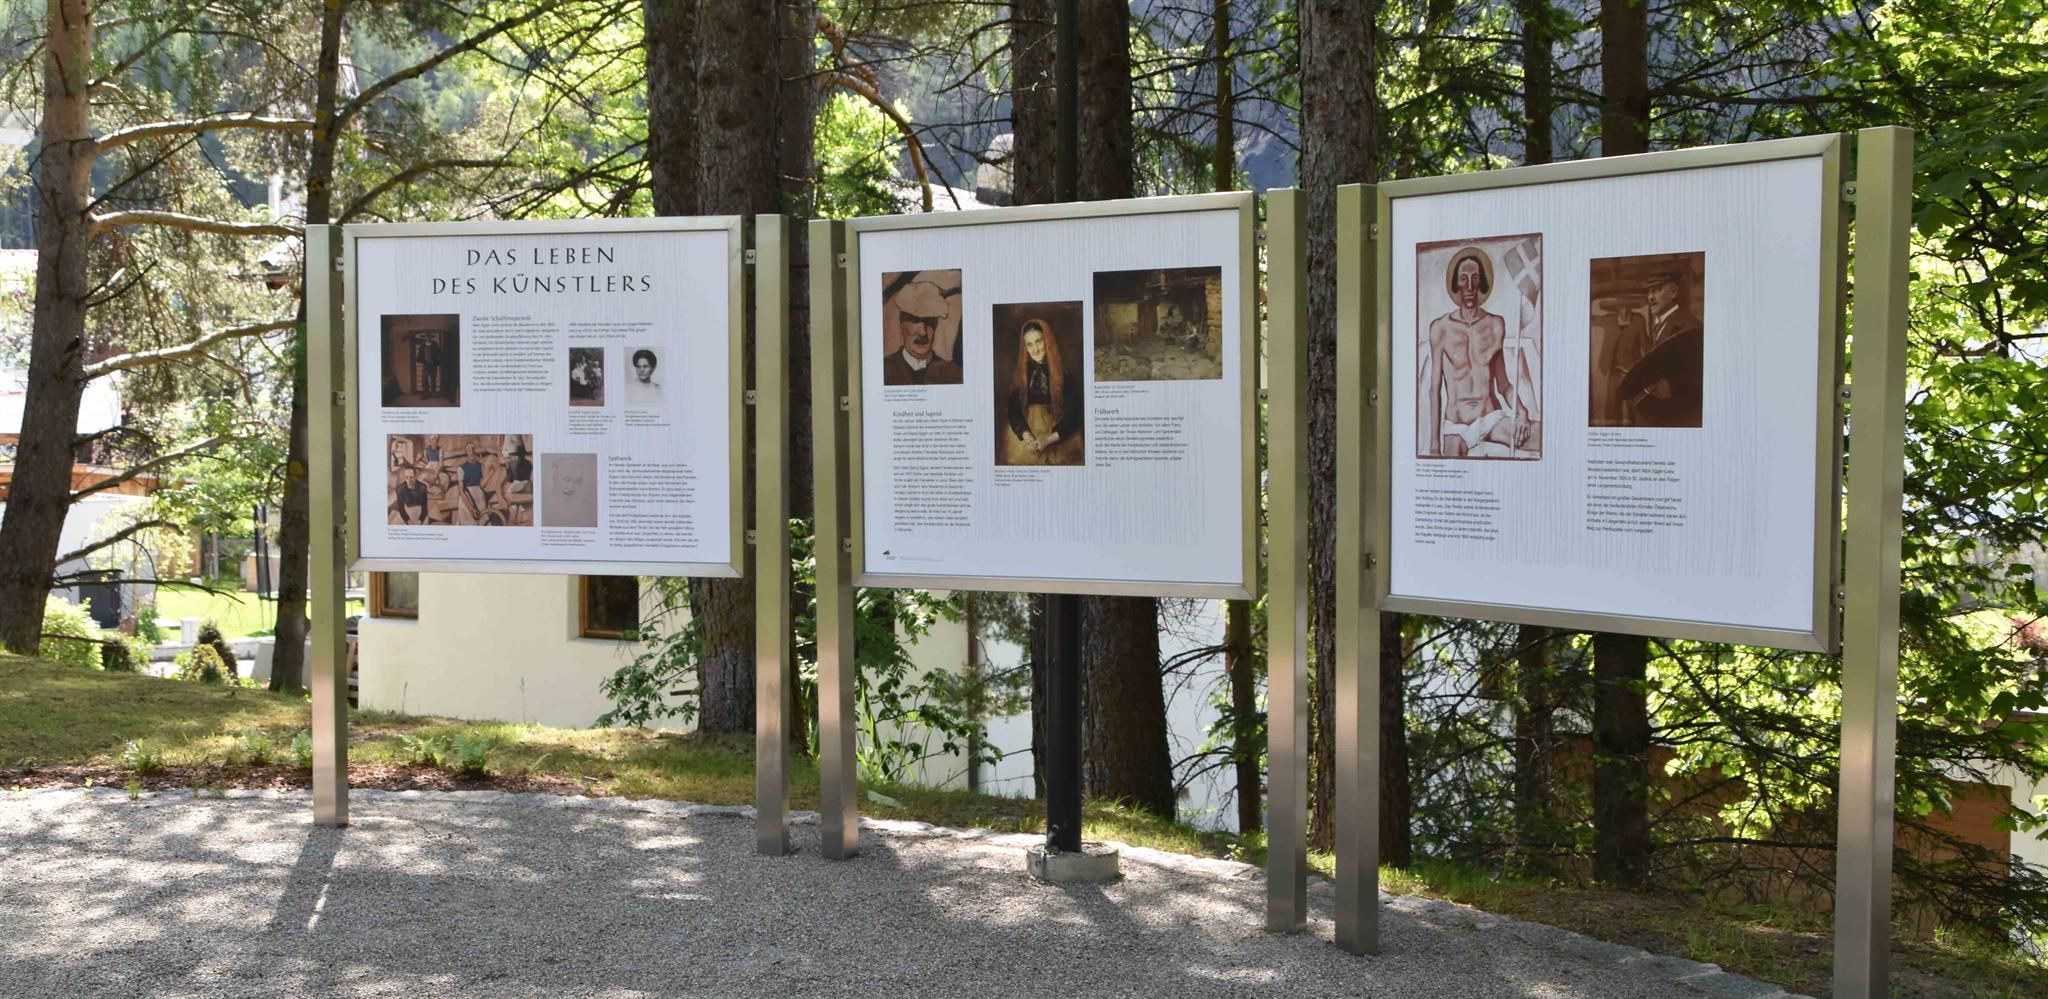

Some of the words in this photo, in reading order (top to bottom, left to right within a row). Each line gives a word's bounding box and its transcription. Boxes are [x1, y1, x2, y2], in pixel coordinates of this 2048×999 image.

[466, 249, 516, 266] DAS
[534, 247, 614, 265] LEBEN
[433, 278, 476, 295] DES
[493, 273, 651, 294] KÜNSTLERS
